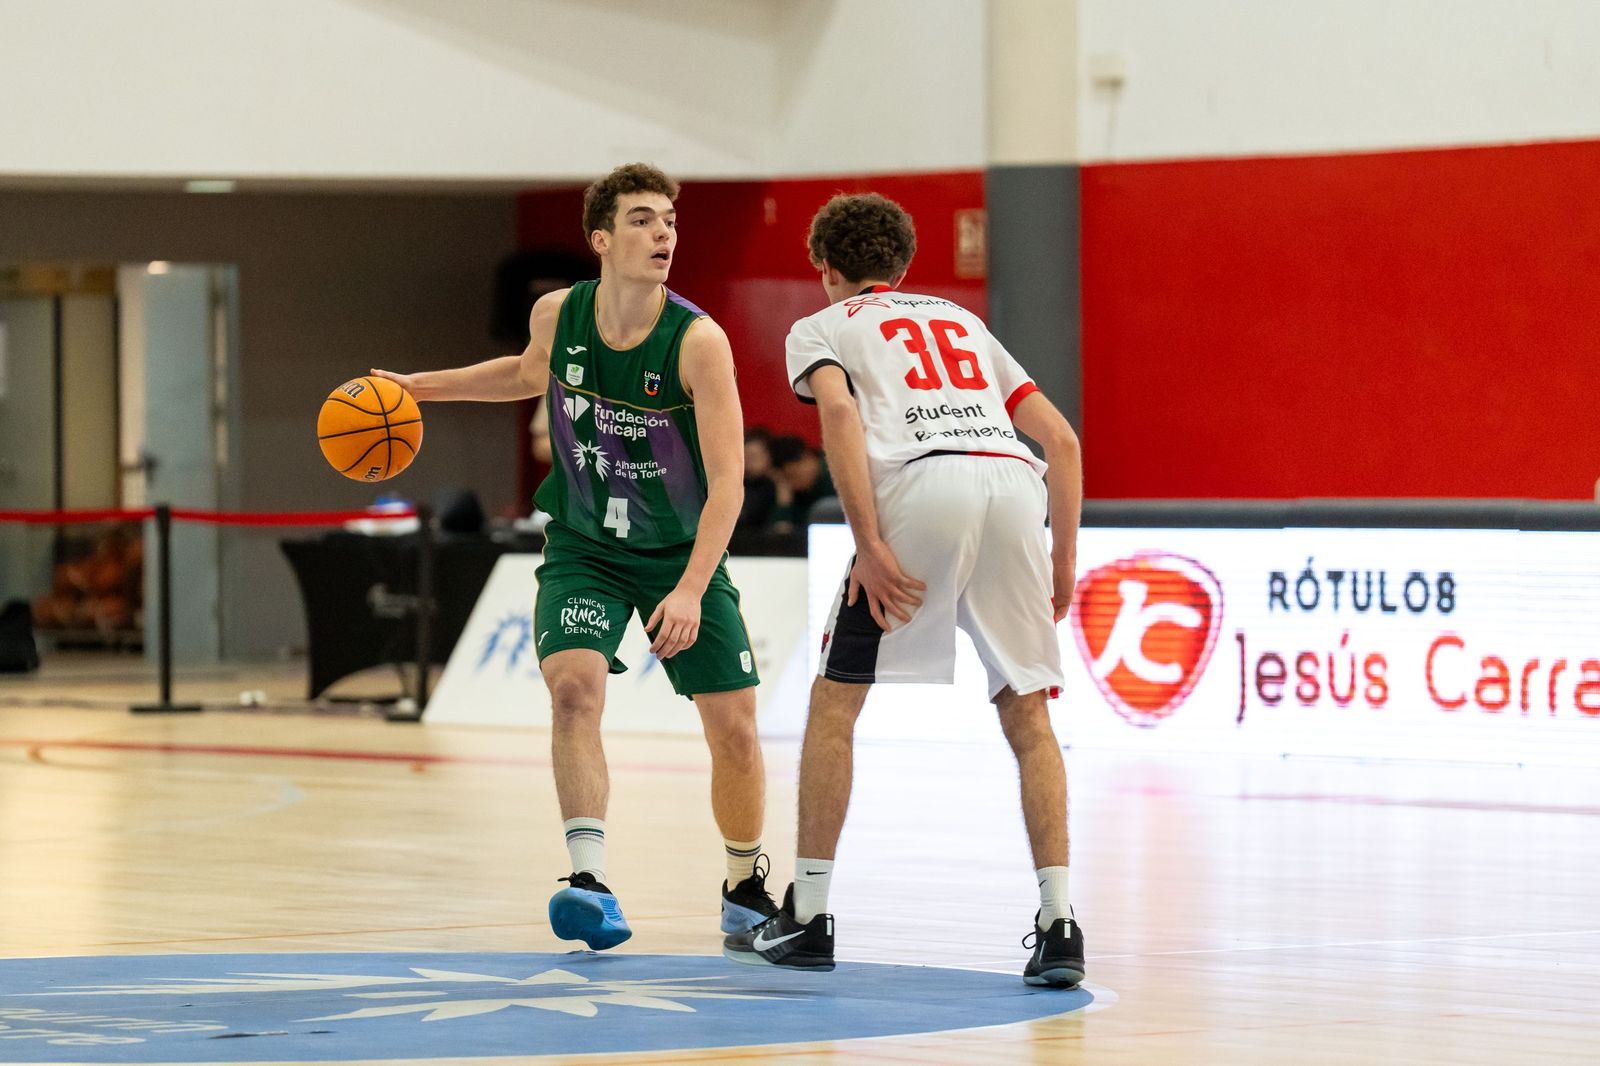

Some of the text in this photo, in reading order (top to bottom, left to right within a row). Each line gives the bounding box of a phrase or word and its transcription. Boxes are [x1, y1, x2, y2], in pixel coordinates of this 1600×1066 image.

[880, 317, 989, 391] 36
[644, 370, 661, 381] LIGA
[594, 402, 669, 428] Fundación
[595, 416, 647, 442] Unicaja
[615, 460, 658, 470] Alhaurín
[615, 467, 667, 480] de la Torre
[603, 496, 631, 539] 4
[564, 626, 602, 639] DENTAL
[1235, 630, 1600, 726] Jesús Carra
